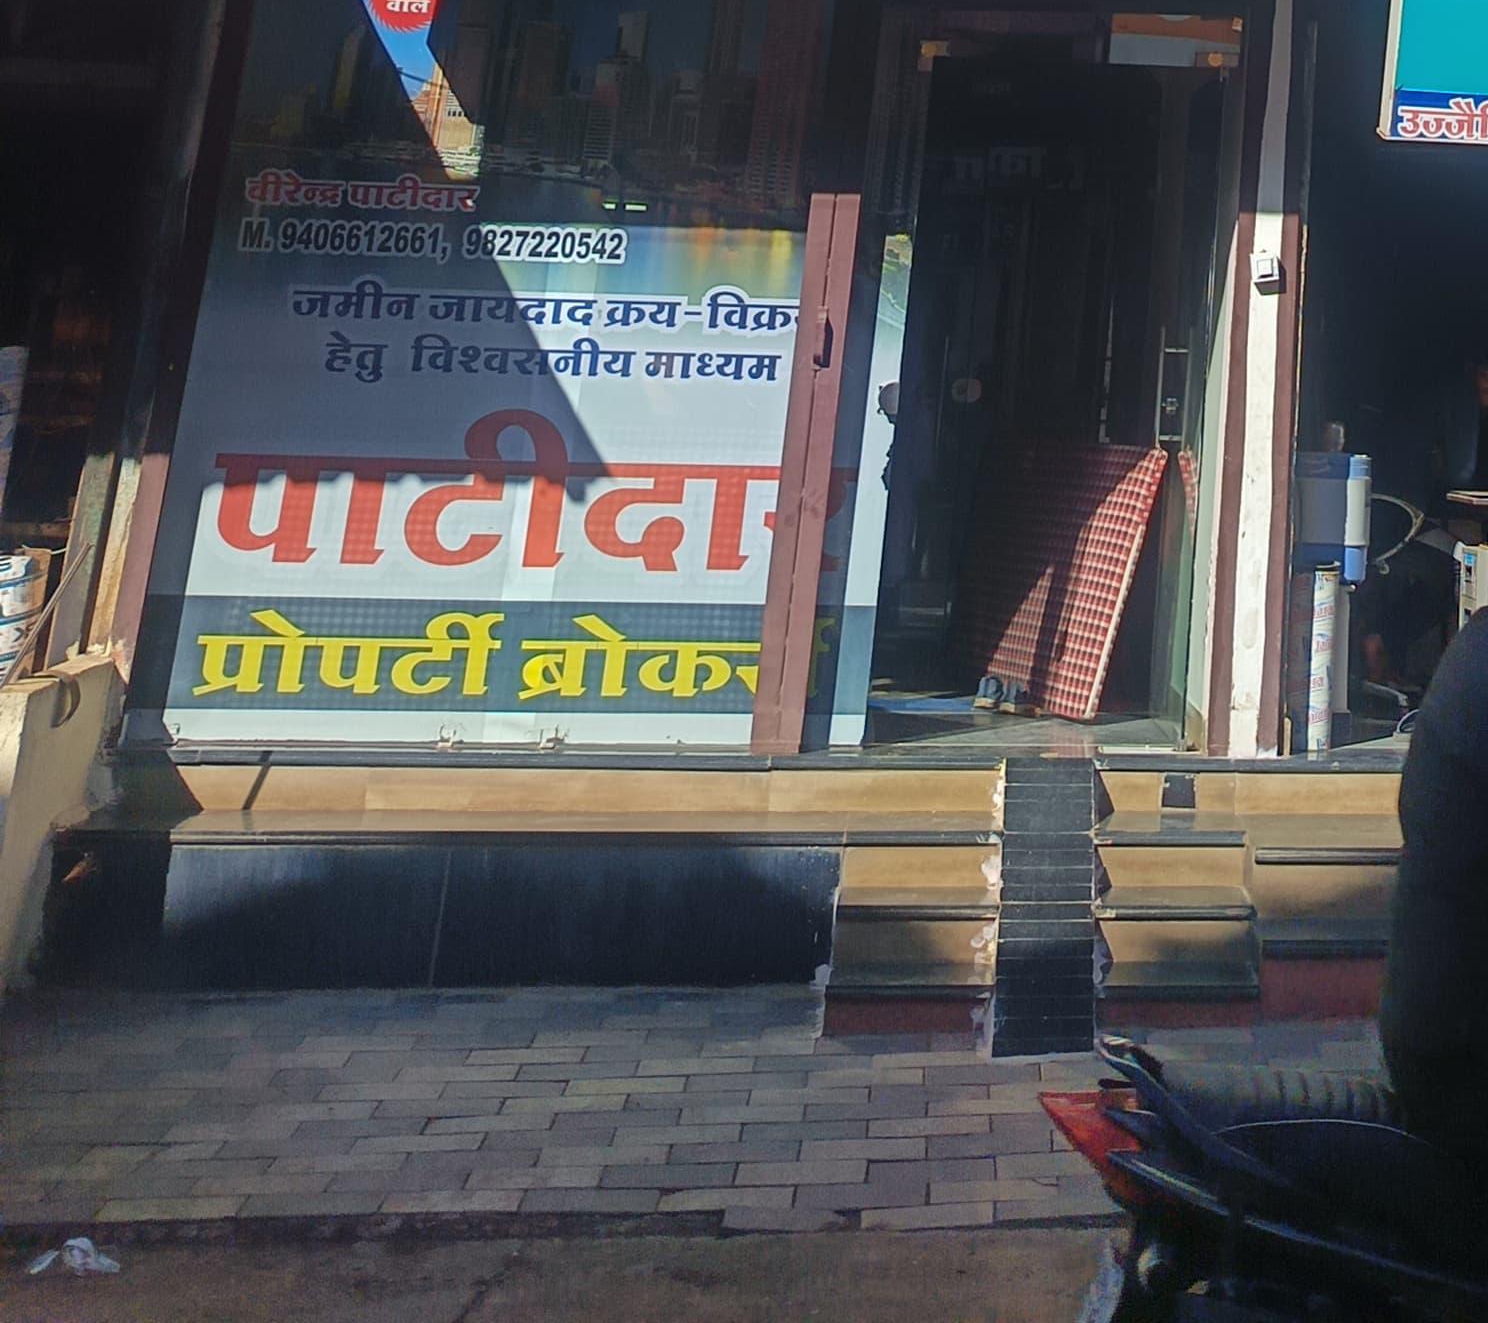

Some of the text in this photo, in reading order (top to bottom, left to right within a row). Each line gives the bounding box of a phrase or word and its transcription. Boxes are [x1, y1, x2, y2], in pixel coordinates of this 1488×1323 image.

[245, 169, 480, 212] वीरेन्द्र पाटीदार
[241, 219, 626, 263] M. 9406612661, 9827220542
[292, 279, 800, 332] जमीन जायदाद क्रय-विक्र
[324, 330, 783, 383] हेतु विश्वसनीय माध्यम
[214, 408, 782, 572] पाटीदा
[192, 608, 505, 697] प्रोपर्टी
